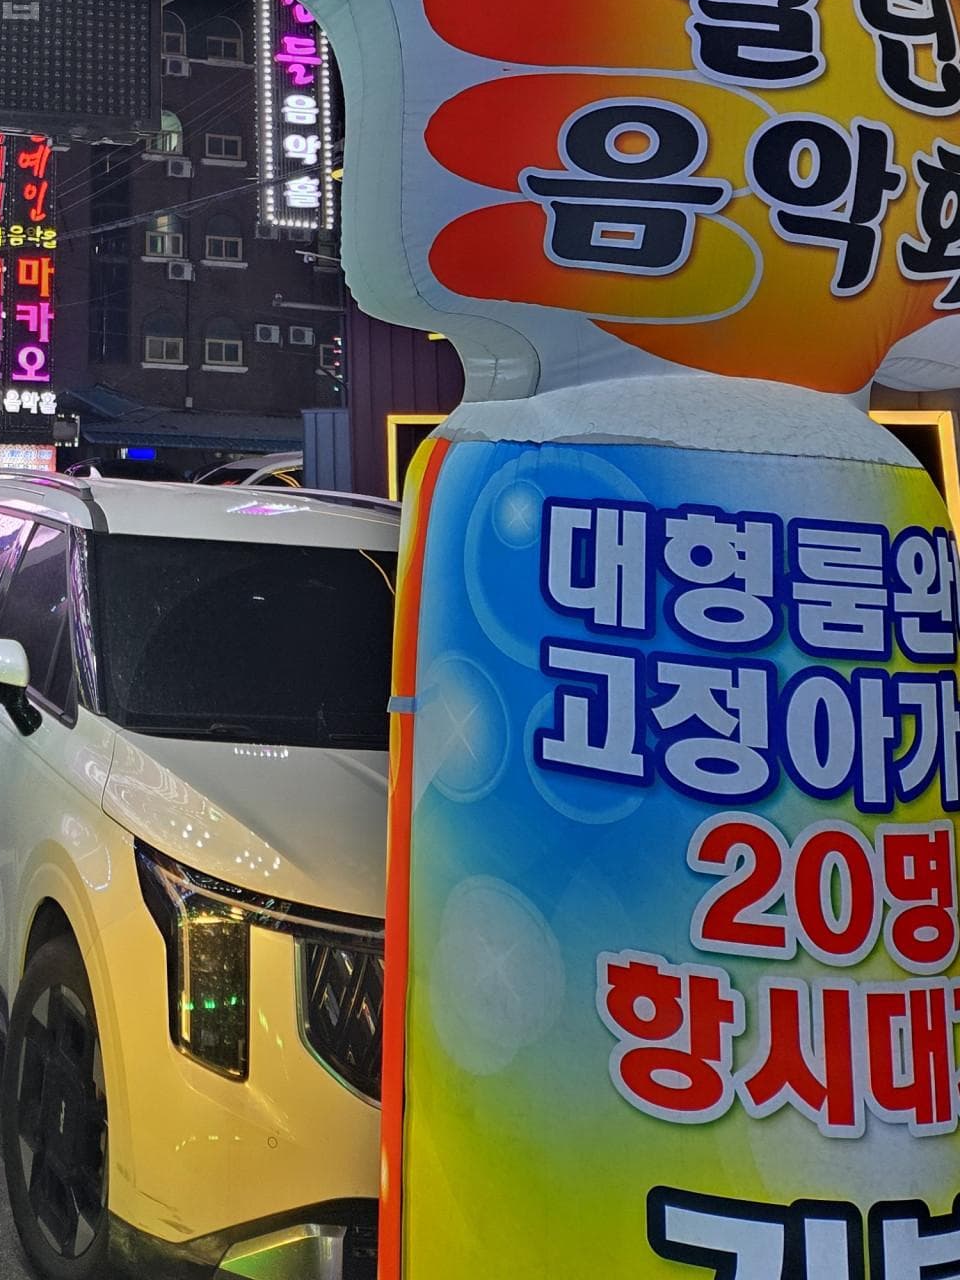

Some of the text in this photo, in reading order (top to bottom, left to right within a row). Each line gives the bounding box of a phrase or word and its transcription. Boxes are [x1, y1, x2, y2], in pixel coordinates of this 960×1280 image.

[17, 135, 52, 223] 예인
[12, 257, 55, 383] 마카오
[545, 502, 960, 658] 대형룸완
[692, 816, 958, 970] 20명
[603, 956, 960, 1130] 항시대
